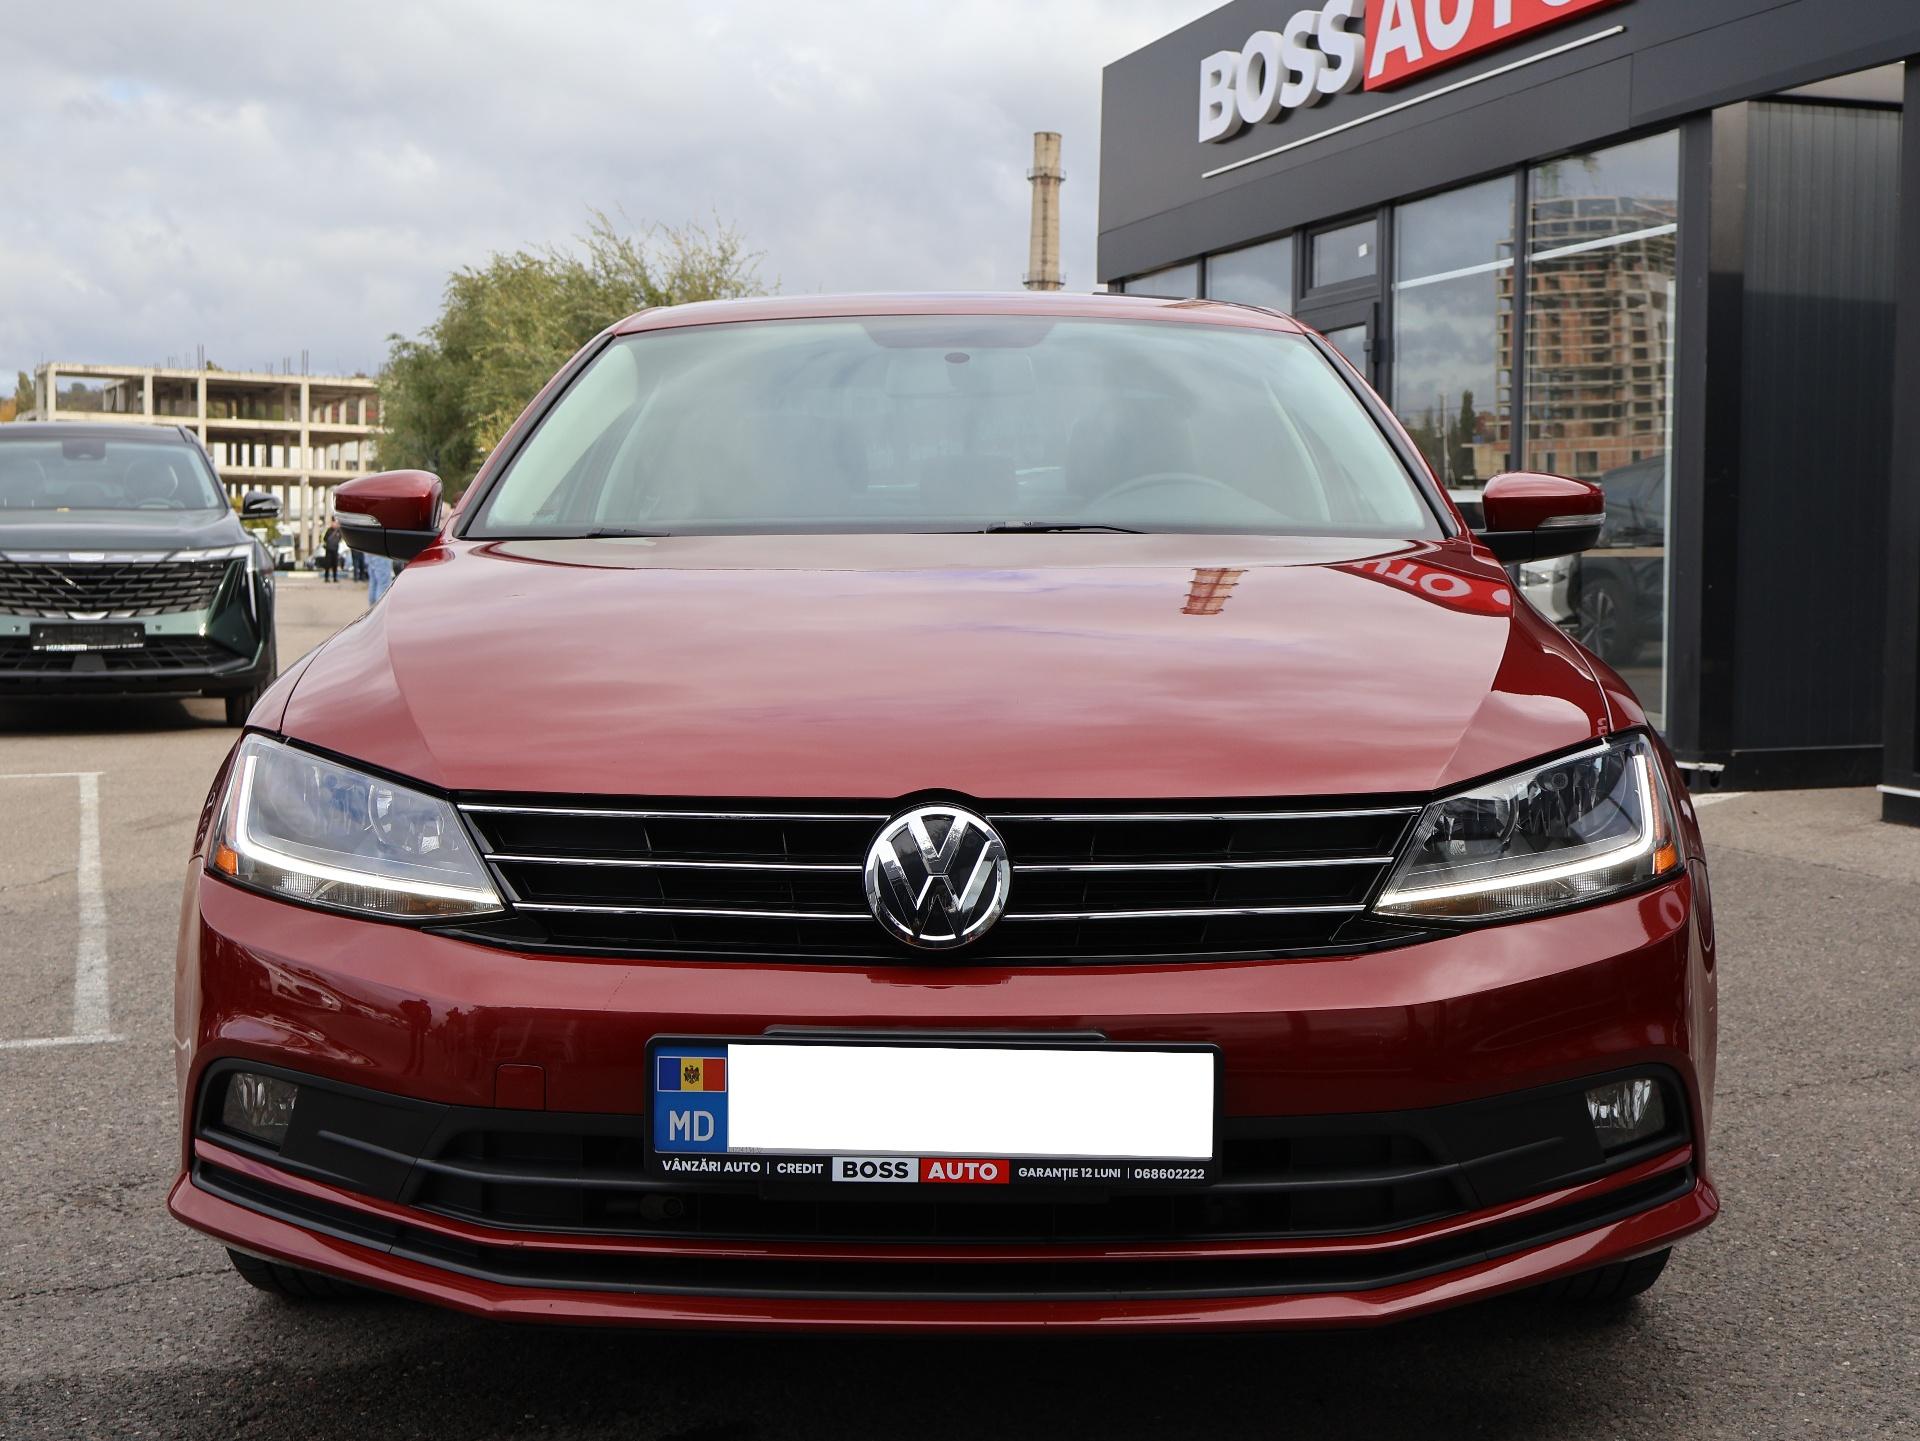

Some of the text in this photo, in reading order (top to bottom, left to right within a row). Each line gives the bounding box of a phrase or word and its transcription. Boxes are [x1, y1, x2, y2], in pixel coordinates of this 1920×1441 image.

[1199, 0, 1571, 143] BOSS AU
[669, 1110, 715, 1142] MD
[662, 1157, 721, 1172] VÂNZĂRI
[724, 1161, 761, 1173] AUTO
[777, 1162, 824, 1174] CREDIT
[842, 1161, 909, 1179] BOSS
[928, 1162, 998, 1180] AUTO
[1080, 1168, 1093, 1178] 12
[1094, 1168, 1121, 1178] LUNI
[1134, 1168, 1205, 1180] 068602222
